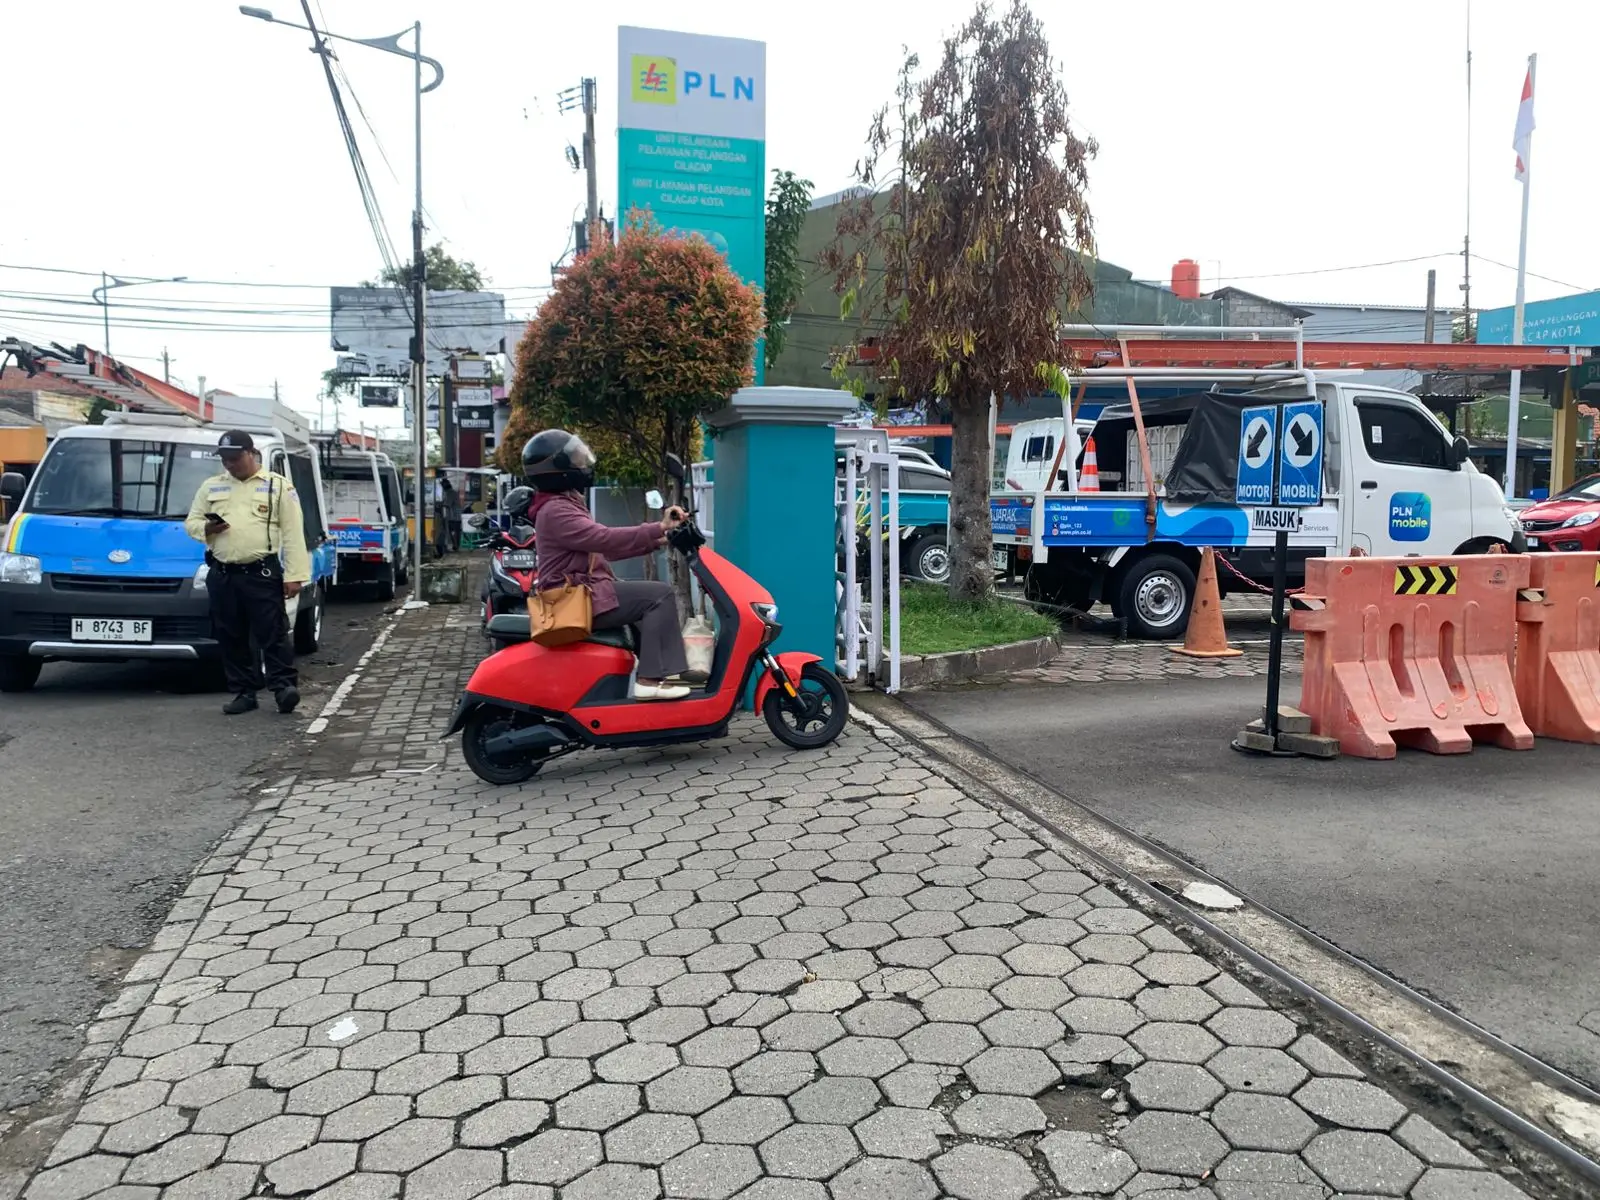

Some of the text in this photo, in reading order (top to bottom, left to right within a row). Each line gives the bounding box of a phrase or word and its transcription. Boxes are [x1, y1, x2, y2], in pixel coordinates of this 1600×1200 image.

[684, 70, 754, 101] PLN
[655, 133, 675, 143] UNIT
[701, 196, 725, 207] KOTA
[1552, 325, 1581, 339] KOTA
[1238, 485, 1270, 498] MOTOR
[1281, 484, 1317, 498] MOBIL
[1392, 506, 1413, 517] PLN
[1255, 510, 1296, 529] MASUK
[1391, 517, 1428, 528] mobile
[1303, 524, 1329, 532] Services
[75, 620, 149, 634] H 8743 BF
